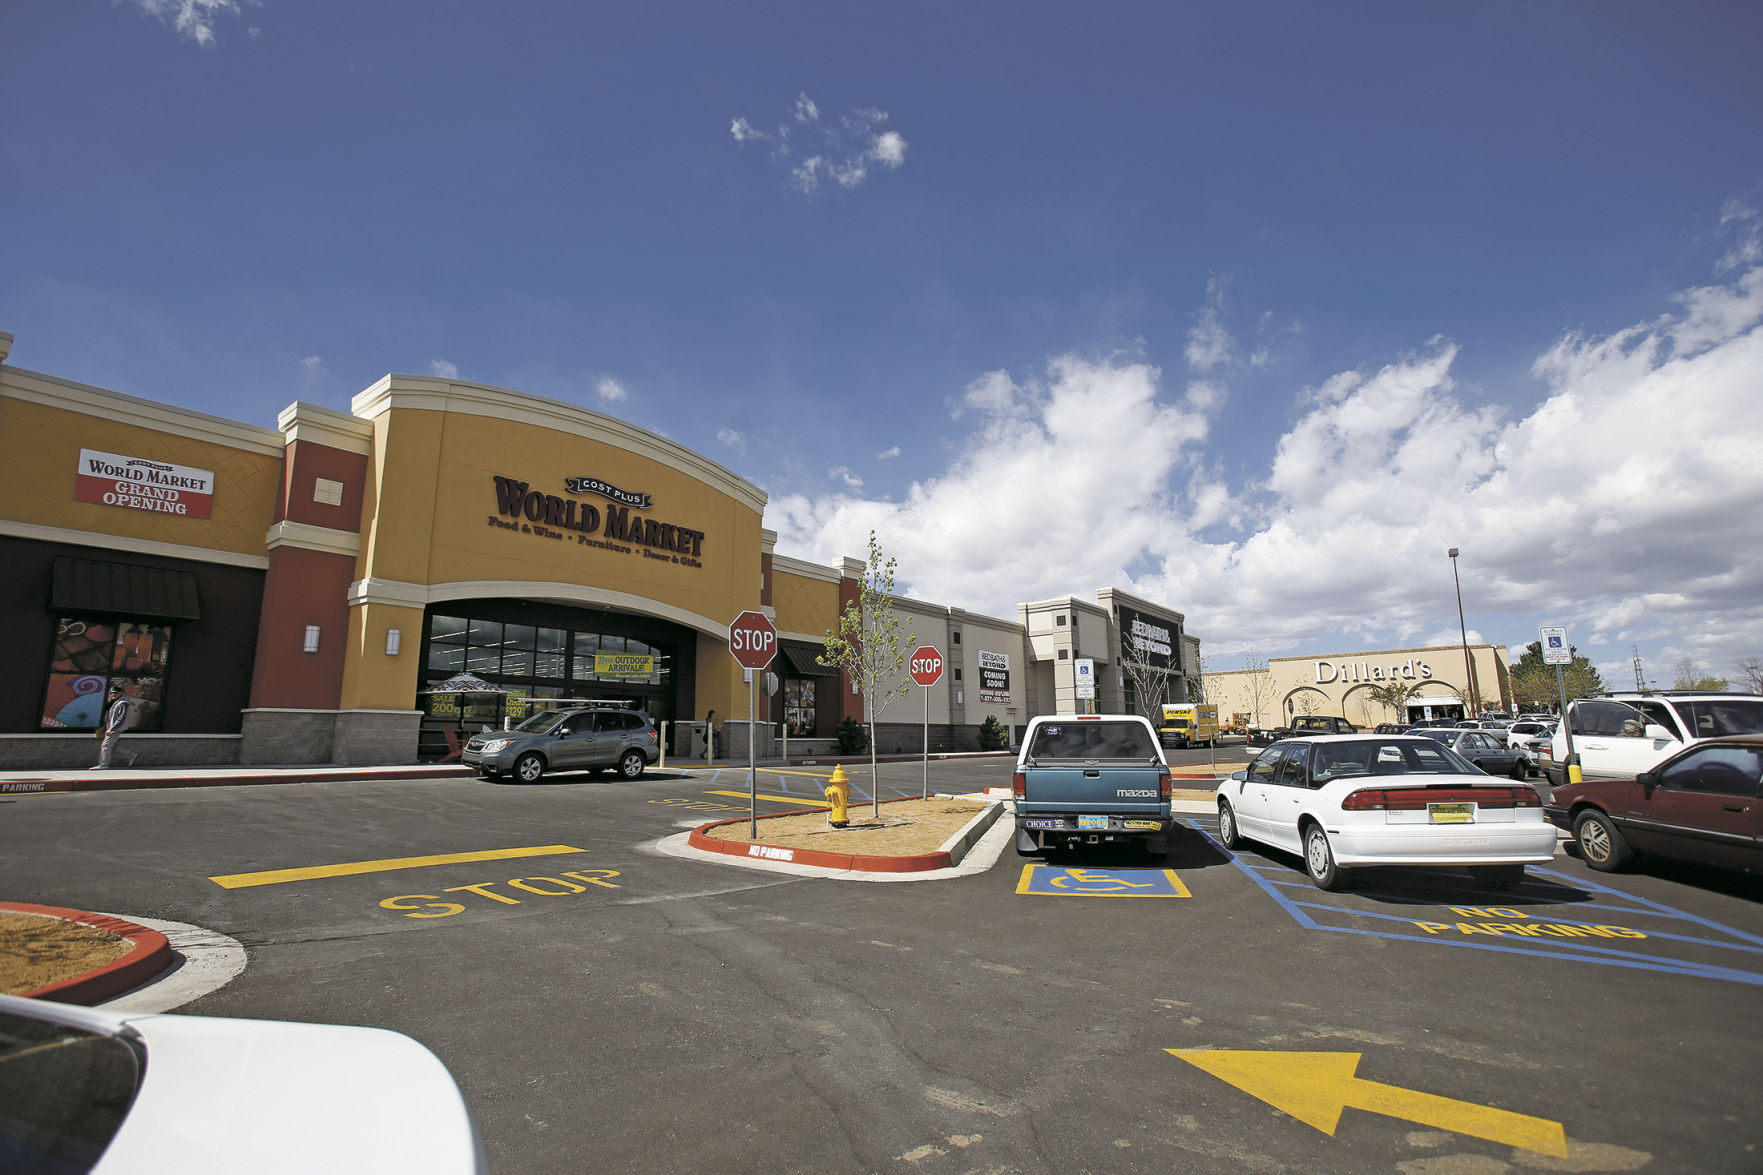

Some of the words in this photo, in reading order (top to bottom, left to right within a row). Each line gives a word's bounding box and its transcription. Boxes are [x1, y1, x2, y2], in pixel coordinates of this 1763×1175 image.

[88, 459, 144, 480] WORLD
[146, 469, 206, 490] MARKET
[115, 481, 179, 501] GRAND
[582, 480, 611, 494] COST
[614, 489, 640, 503] PLUS
[103, 492, 187, 515] OPENING
[493, 475, 600, 533] WORLD
[603, 503, 704, 557] MARKET
[488, 515, 519, 531] Food
[521, 523, 531, 534] &
[533, 525, 563, 540] Wine
[578, 534, 631, 554] Furniture
[671, 556, 679, 564] &
[680, 557, 702, 568] Gifts
[733, 628, 773, 651] STOP
[608, 664, 645, 672] ARRIVALS!
[615, 656, 649, 664] OUTDOOR
[911, 658, 941, 674] STOP
[982, 660, 1006, 669] BEYOND
[983, 670, 1006, 680] COMING
[1314, 658, 1432, 684] Dillard's
[986, 679, 1005, 688] SOON!
[2, 783, 45, 791] PARKING
[1026, 819, 1053, 829] CHOICE
[749, 845, 760, 857] NO
[761, 846, 794, 861] PARKING
[379, 869, 621, 918] STOP
[1449, 906, 1530, 918] NO
[1412, 921, 1648, 939] PARKING
